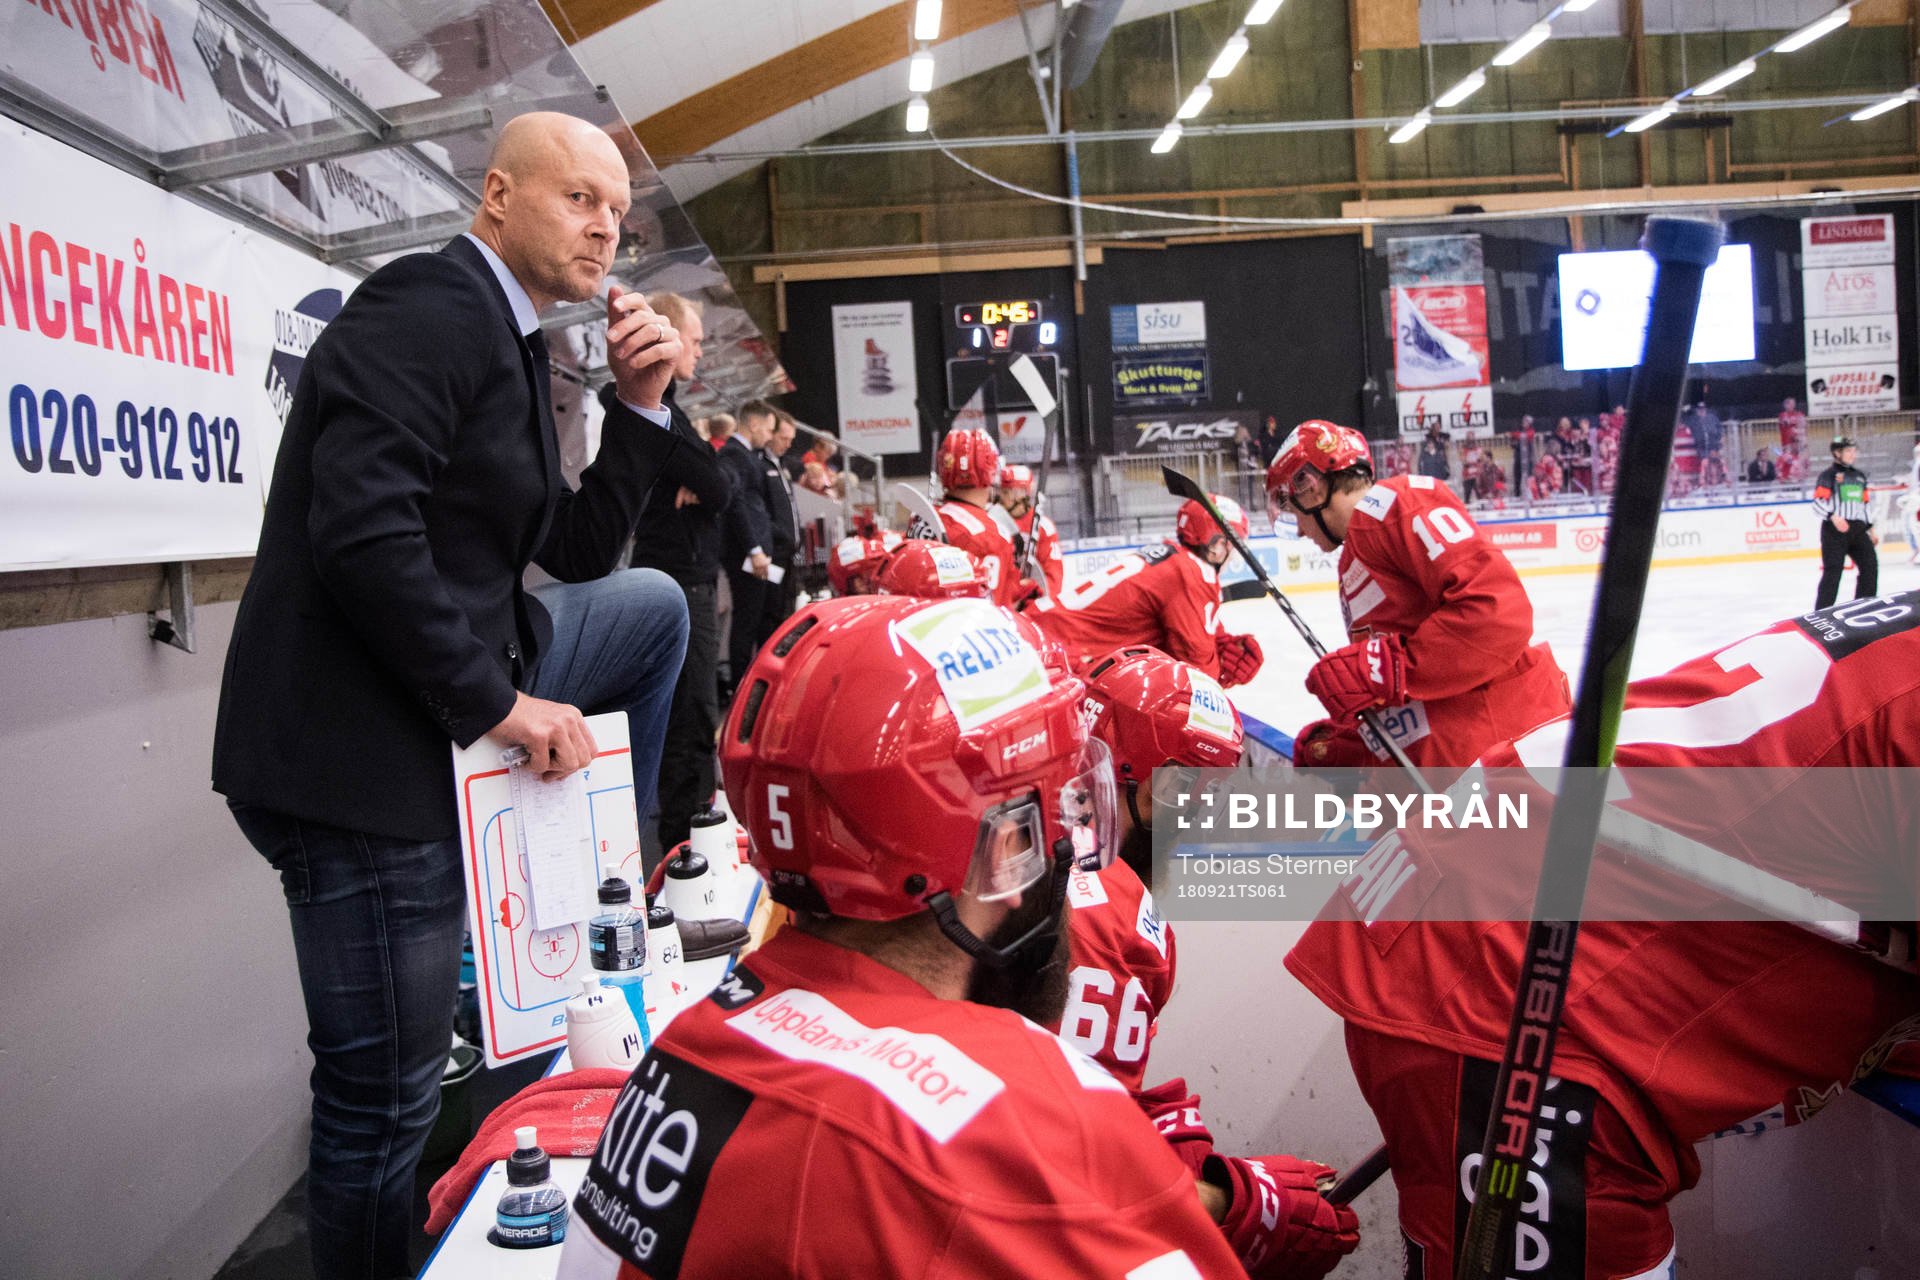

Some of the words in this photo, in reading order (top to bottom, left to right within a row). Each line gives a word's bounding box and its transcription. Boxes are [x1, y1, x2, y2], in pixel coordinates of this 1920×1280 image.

[1824, 271, 1876, 292] Aros
[994, 329, 1008, 347] 2
[1039, 322, 1057, 345] 0
[1117, 365, 1203, 385] Skuttunge
[1183, 381, 1198, 392] AB
[9, 383, 184, 482] 020-912
[187, 411, 243, 484] 912
[1135, 417, 1239, 448] TACKS
[1755, 511, 1787, 528] ICA
[1412, 507, 1475, 562] 10
[1003, 730, 1048, 760] CCM
[1196, 742, 1220, 754] CCM
[767, 783, 794, 850] 5
[703, 889, 715, 906] 10
[662, 943, 679, 964] 82
[1059, 966, 1151, 1061] 66
[622, 1033, 640, 1059] 14
[862, 1033, 969, 1107] Motor
